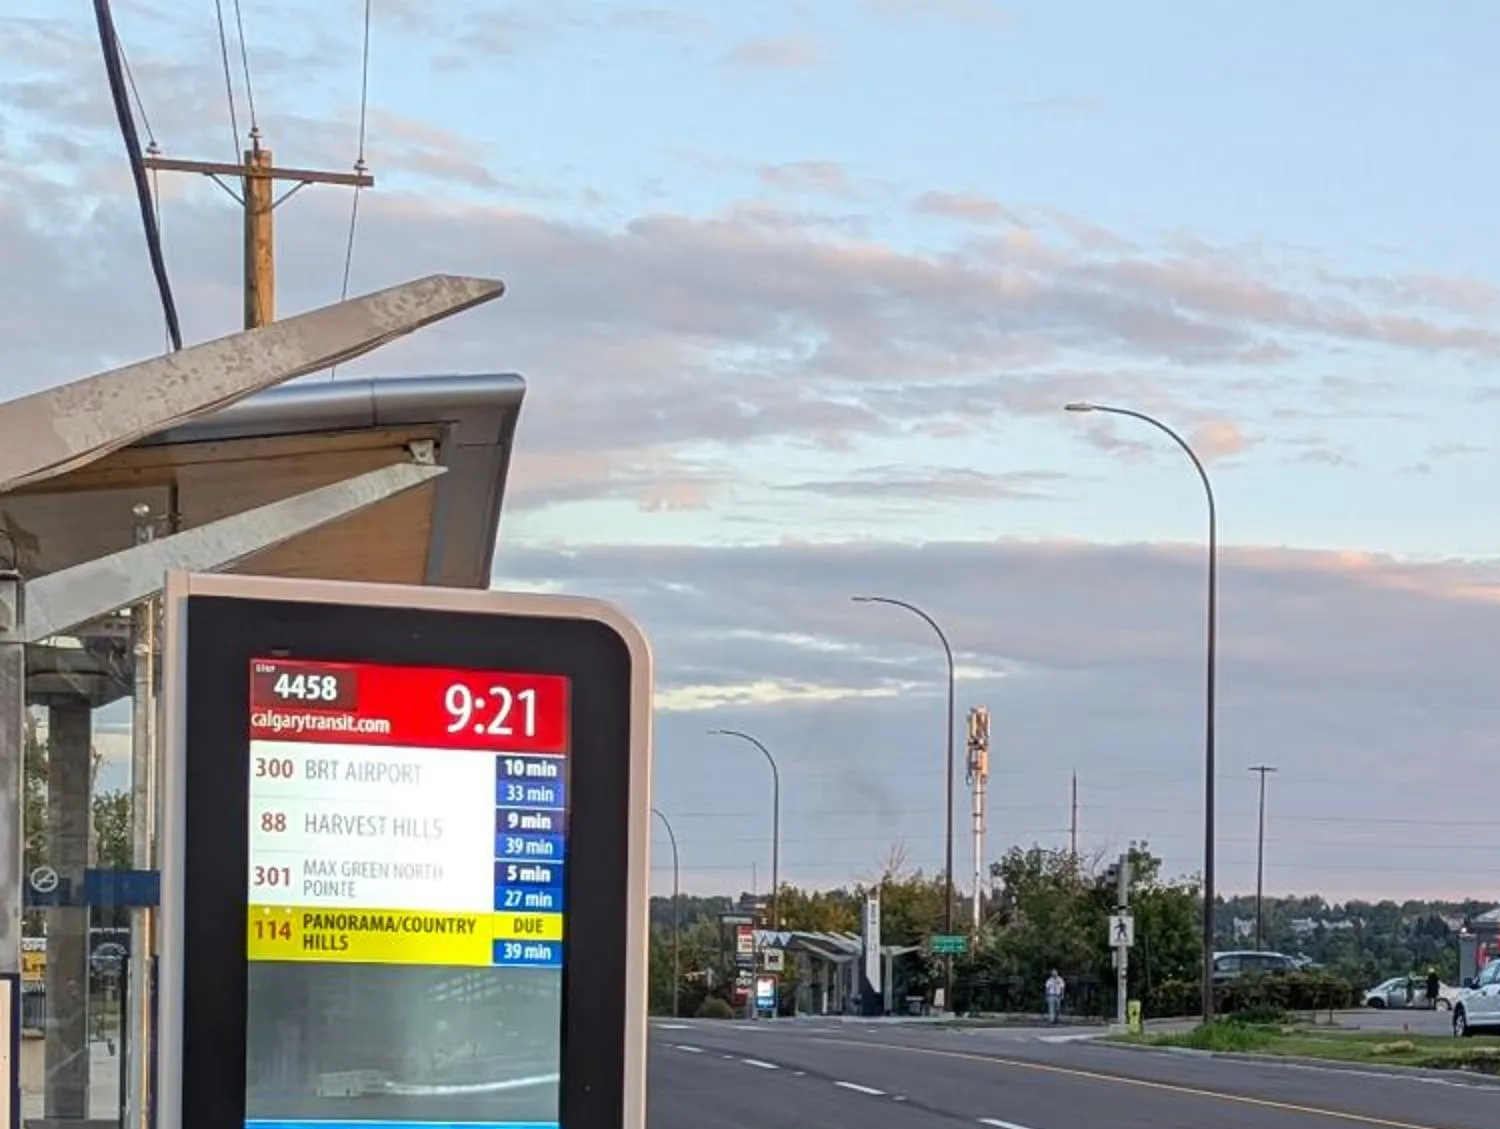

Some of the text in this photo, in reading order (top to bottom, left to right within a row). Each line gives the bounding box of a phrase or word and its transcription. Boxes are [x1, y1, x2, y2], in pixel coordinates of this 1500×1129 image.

[273, 673, 337, 701] 4458
[444, 683, 535, 737] 9:21
[251, 709, 391, 734] calgarytransit.com
[255, 757, 422, 785] 300 BRT AIRPORT
[504, 758, 557, 778] 10 min
[506, 783, 555, 803] 33 min
[260, 812, 443, 840] 88 HARVEST HILLS
[507, 811, 552, 831] 9 min
[504, 836, 553, 856] 39 min
[254, 860, 443, 887] 301 MAX GREEN NORTH
[506, 864, 551, 883] 5 min
[303, 880, 356, 898] POINTE
[503, 889, 553, 908] 27 min
[255, 913, 477, 941] 114 PANORAMA/COUNTRY
[513, 918, 544, 934] DUE
[303, 933, 349, 951] HILLS
[503, 942, 552, 961] 39 min
